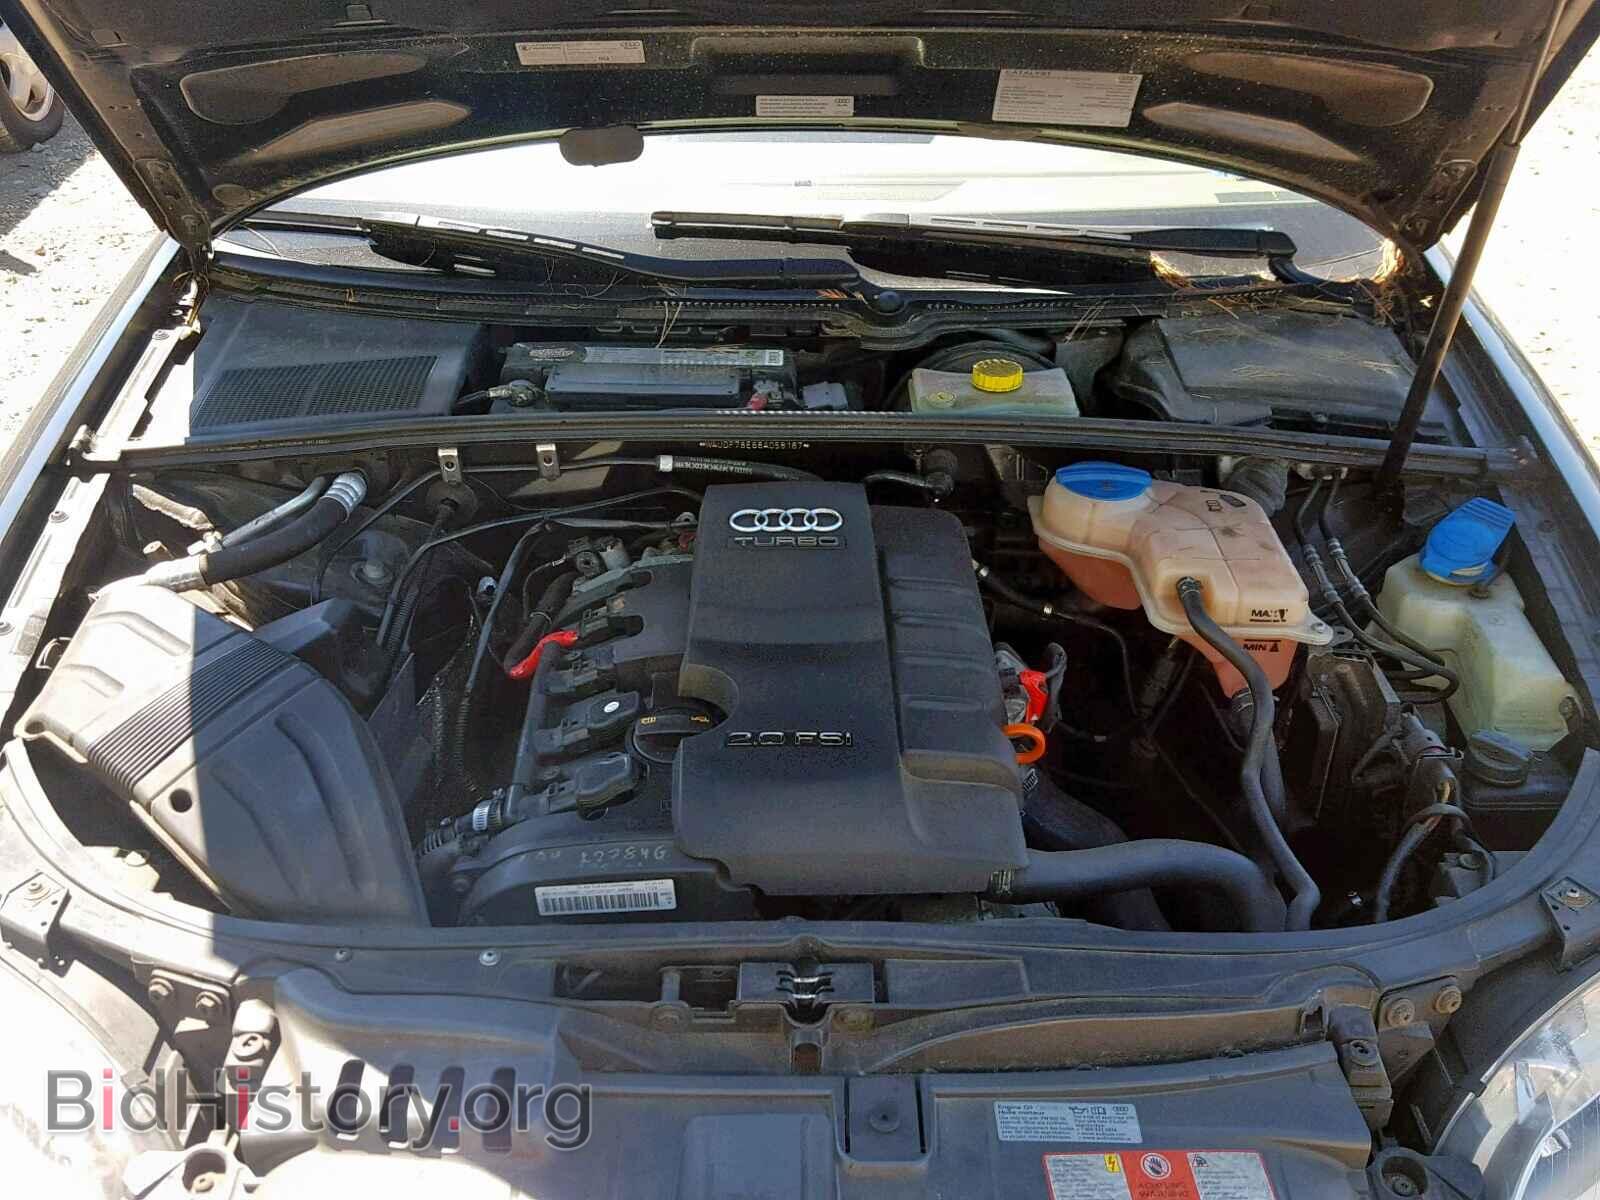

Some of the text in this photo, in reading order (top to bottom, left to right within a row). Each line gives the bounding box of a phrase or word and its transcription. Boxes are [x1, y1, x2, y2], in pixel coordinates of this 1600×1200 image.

[734, 536, 840, 547] TURBO
[1243, 643, 1267, 652] MIN
[727, 731, 785, 747] 2.0
